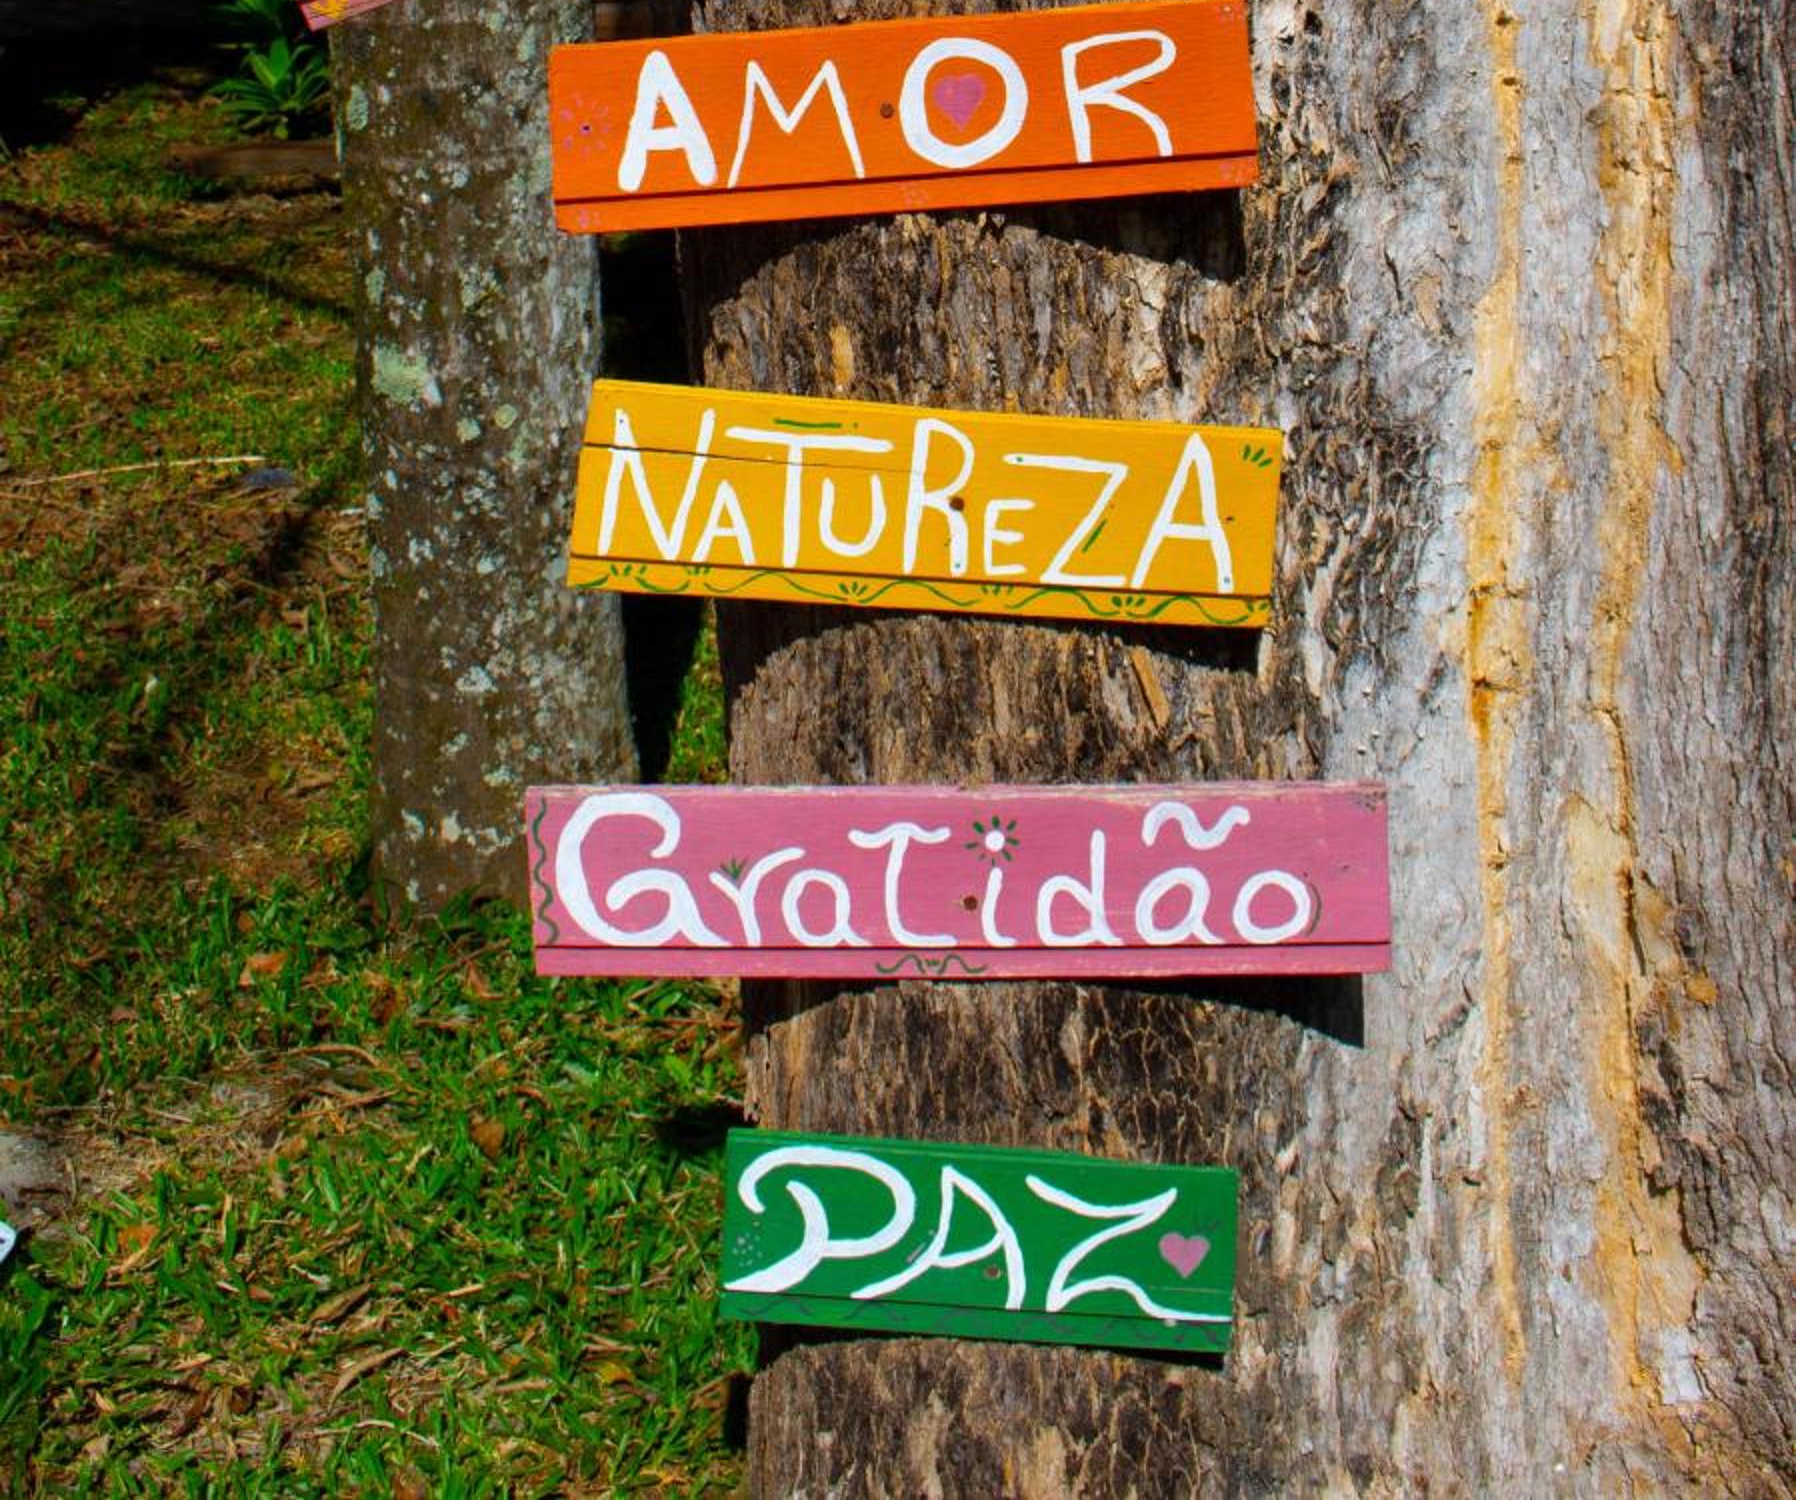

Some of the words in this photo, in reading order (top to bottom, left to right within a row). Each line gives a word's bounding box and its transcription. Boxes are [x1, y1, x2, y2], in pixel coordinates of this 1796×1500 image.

[617, 29, 1178, 193] AMOR
[597, 408, 1234, 594] NATUREZA
[722, 1145, 1234, 1323] PAZ
